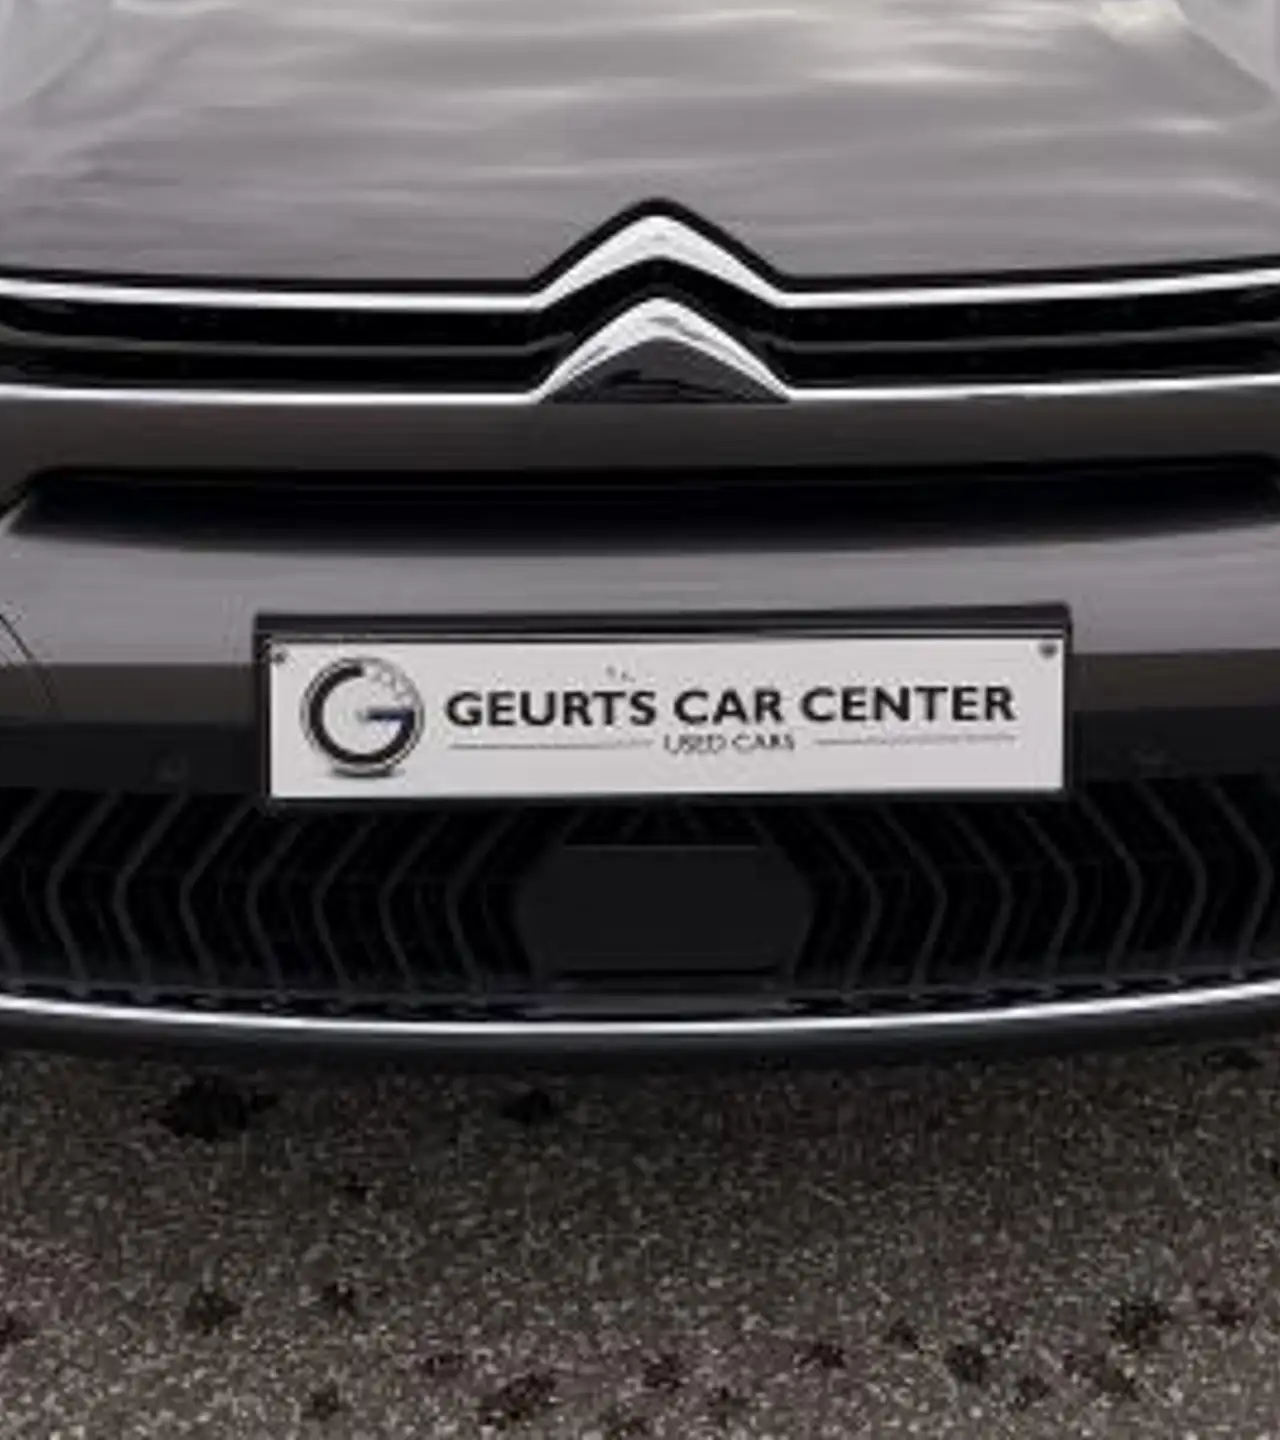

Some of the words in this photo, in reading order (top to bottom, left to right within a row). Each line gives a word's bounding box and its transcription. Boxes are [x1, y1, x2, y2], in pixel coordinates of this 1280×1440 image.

[444, 689, 658, 728] GEURTS
[672, 687, 785, 727] CAR
[799, 684, 1017, 724] CENTER
[663, 733, 727, 755] USED
[731, 732, 796, 752] CARS
